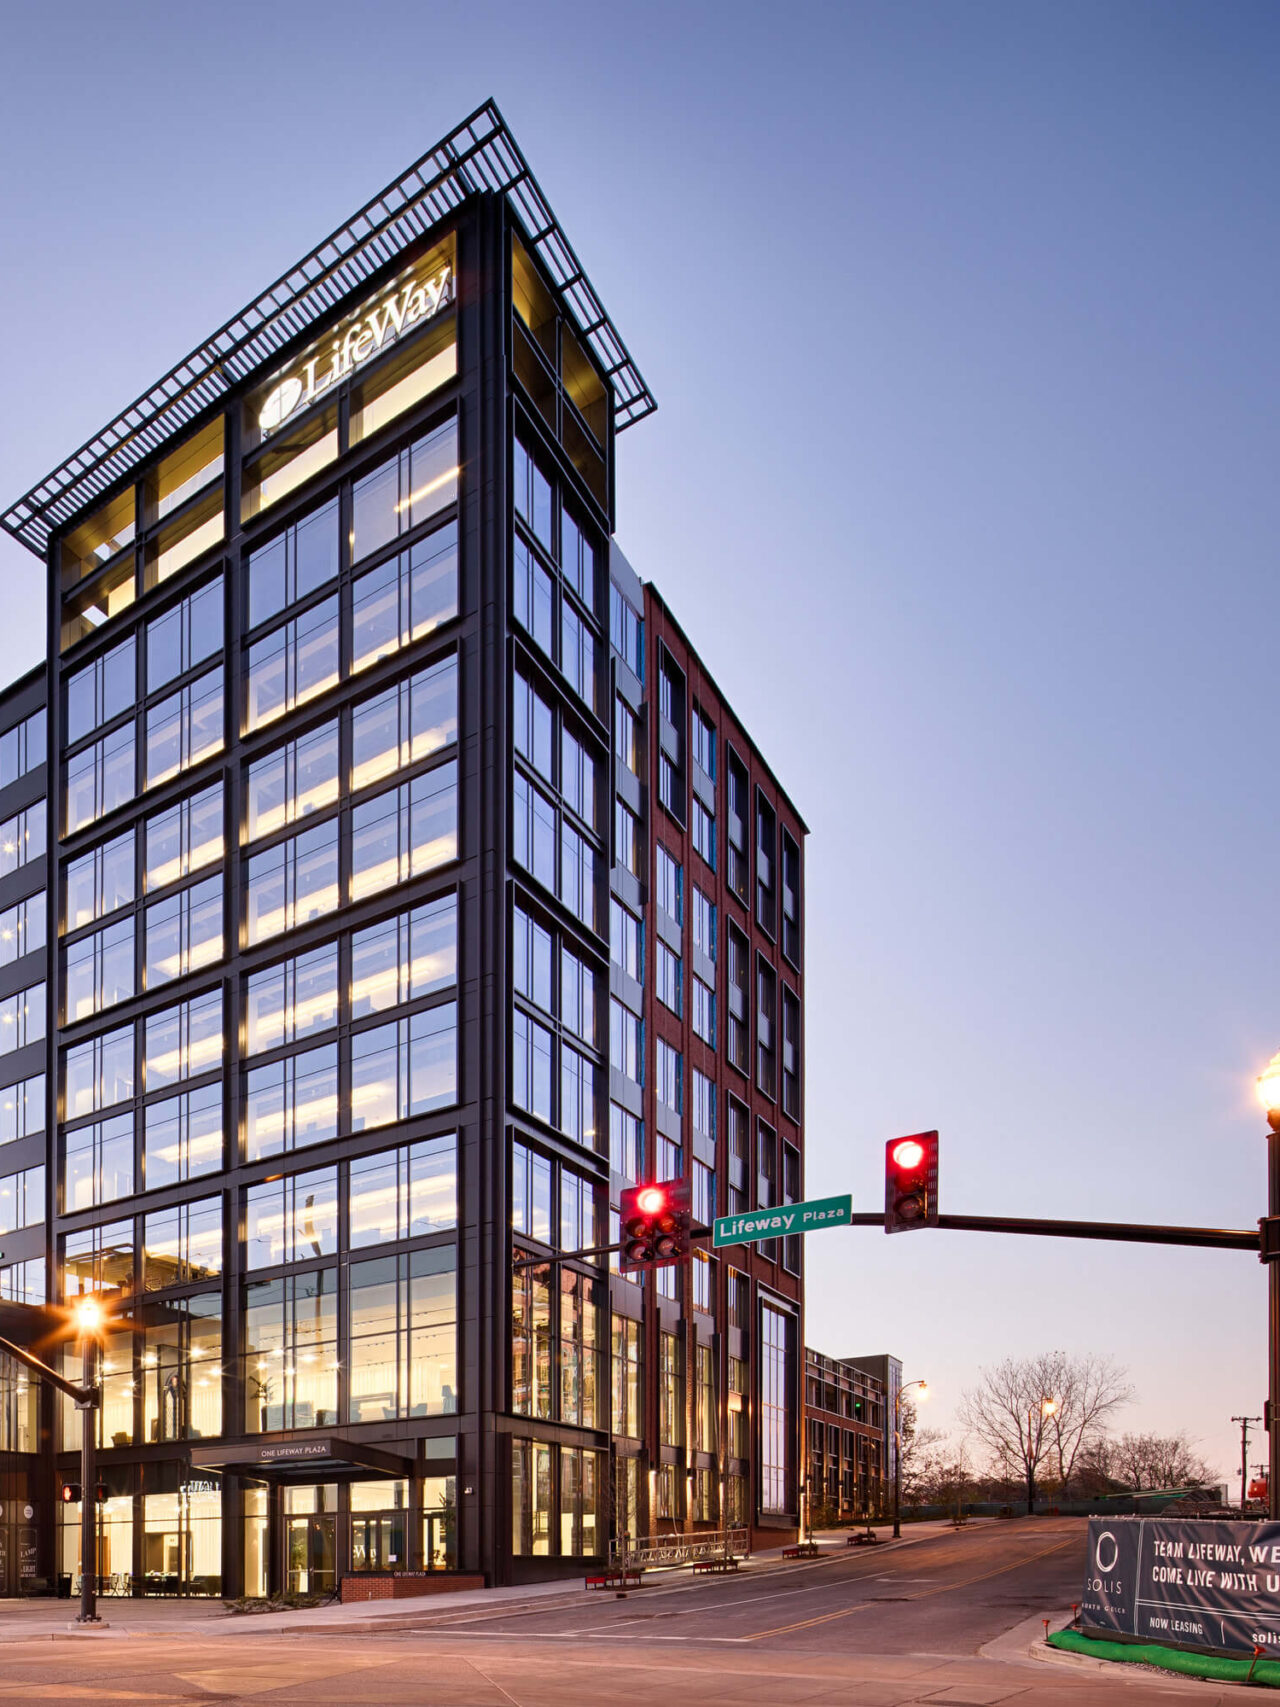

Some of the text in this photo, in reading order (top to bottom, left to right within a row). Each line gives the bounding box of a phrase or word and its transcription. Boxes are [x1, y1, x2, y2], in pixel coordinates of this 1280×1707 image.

[303, 266, 451, 403] LifeWay
[720, 1208, 845, 1237] Lifeway Plaza
[261, 1445, 327, 1457] ONE LIFEWAY PLAZA
[1153, 1540, 1184, 1559] TEAM
[1188, 1543, 1245, 1566] LIFEWAY,
[1087, 1578, 1122, 1594] SOLIS
[1152, 1566, 1183, 1585] COME
[1187, 1568, 1216, 1587] LIVE
[1220, 1571, 1258, 1592] WITH
[1149, 1617, 1204, 1635] NOW LEASING
